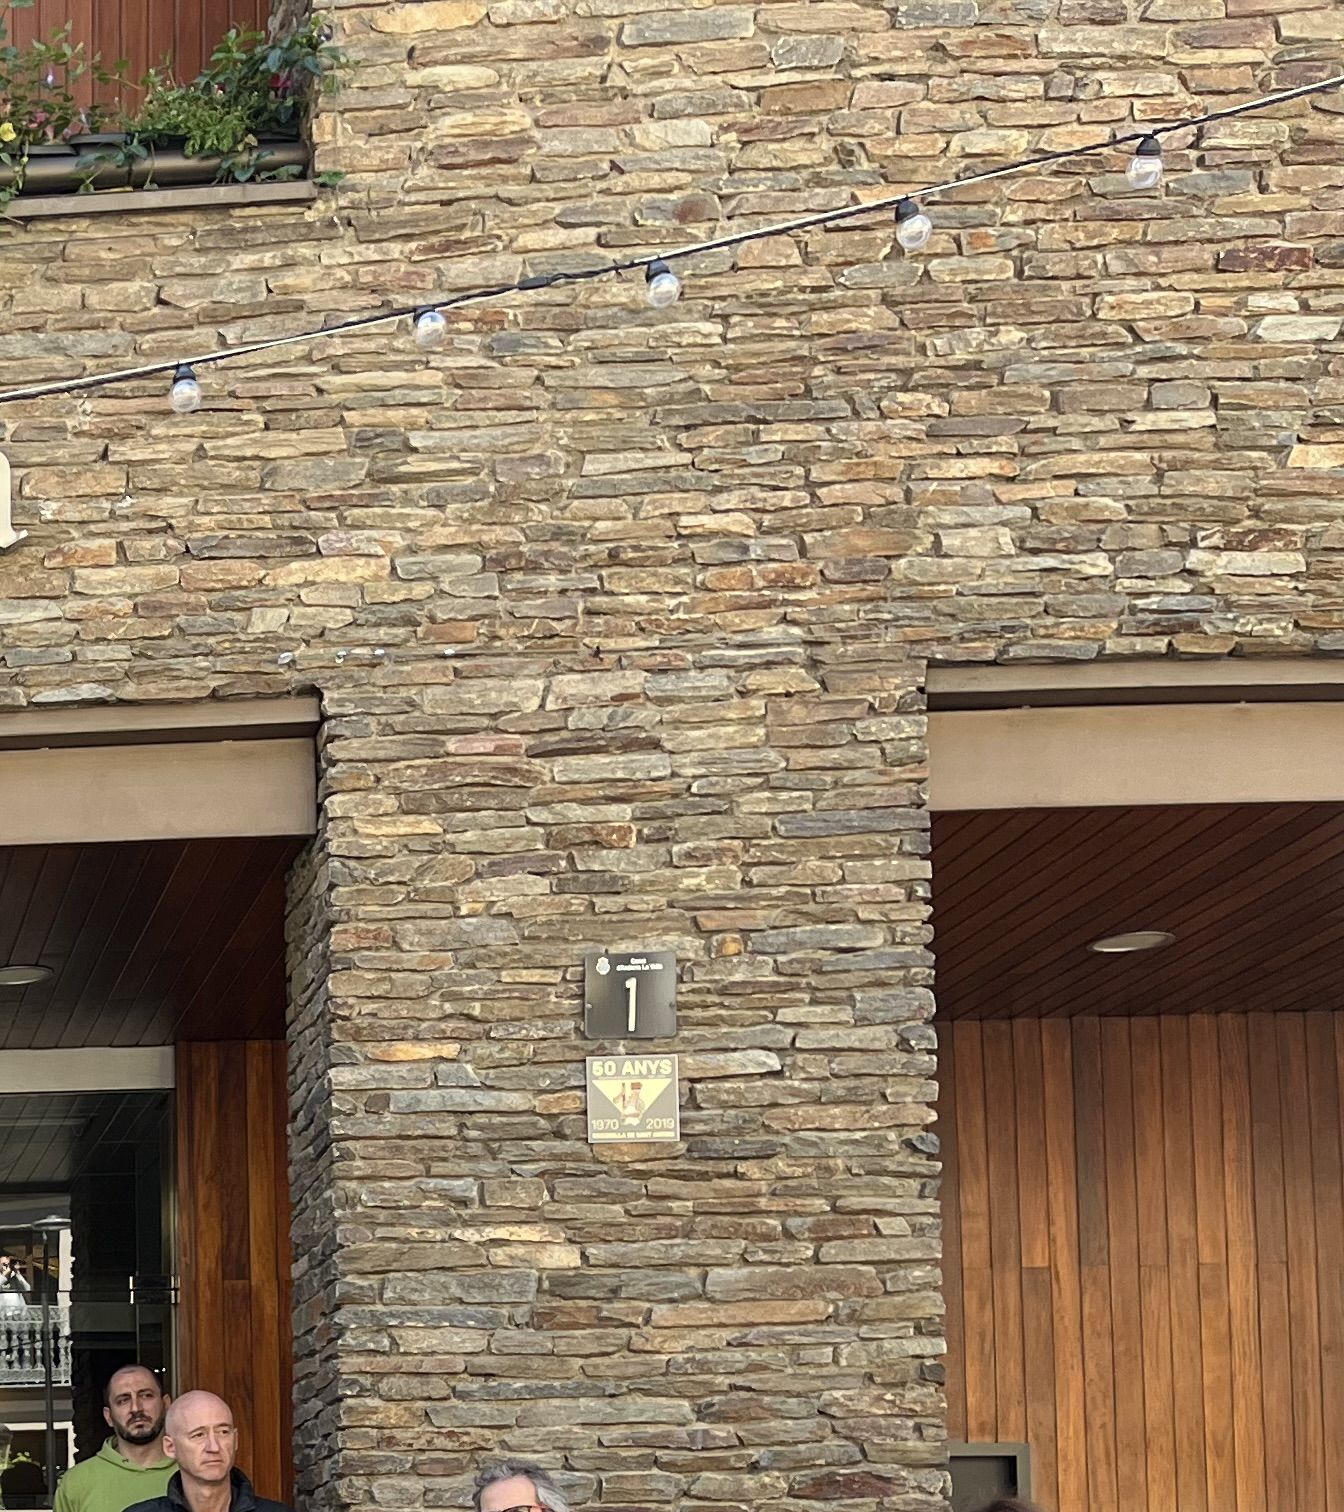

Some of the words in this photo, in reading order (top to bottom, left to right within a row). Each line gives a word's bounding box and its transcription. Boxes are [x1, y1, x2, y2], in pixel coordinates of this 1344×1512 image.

[625, 977, 637, 1031] 1
[592, 1060, 616, 1076] 50
[621, 1059, 672, 1076] ANYS
[591, 1119, 619, 1131] 1970
[645, 1118, 675, 1129] 2019
